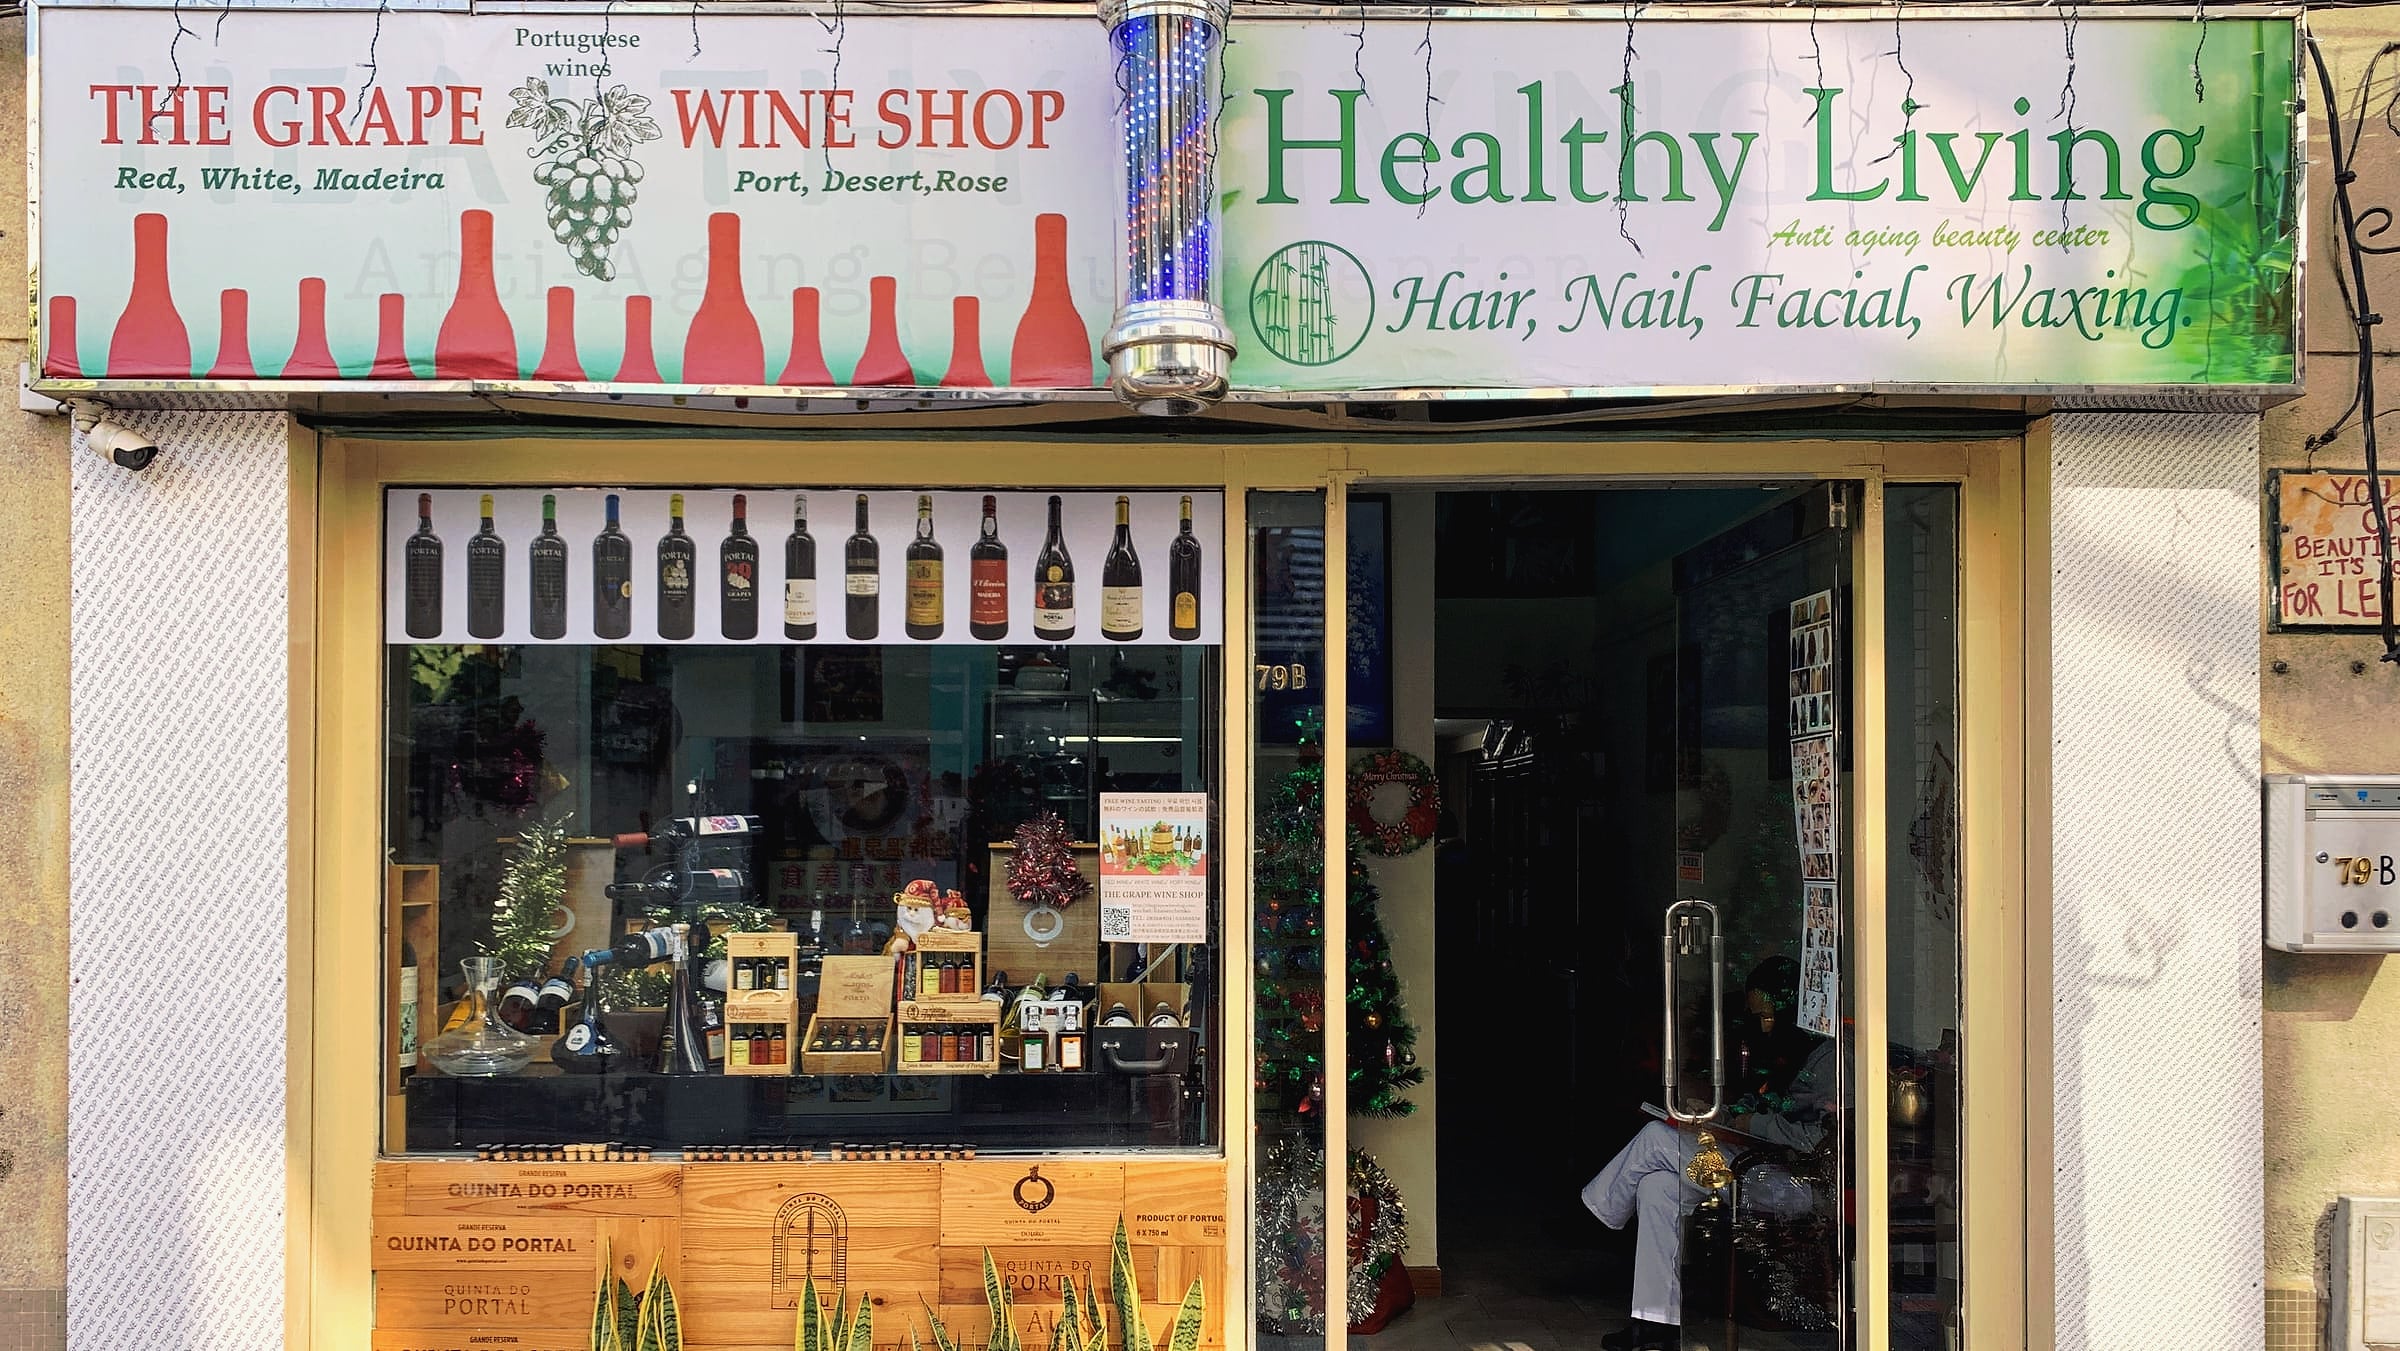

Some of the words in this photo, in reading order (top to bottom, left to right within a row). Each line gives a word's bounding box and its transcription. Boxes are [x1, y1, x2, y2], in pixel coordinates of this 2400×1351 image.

[515, 26, 640, 51] Portuguese
[545, 57, 612, 77] wines
[89, 84, 232, 147] THE
[253, 85, 486, 149] GRAPE
[671, 89, 856, 149] WINE
[877, 89, 1065, 150] SHOP
[1253, 80, 1759, 232] Healthy
[1802, 87, 2204, 231] Living
[114, 166, 187, 194] Red,
[200, 166, 302, 195] White,
[312, 167, 445, 191] Madeira
[734, 170, 809, 196] Port,
[1767, 217, 1831, 249] Anti
[1845, 223, 1919, 257] aging
[1932, 218, 2020, 255] beauty
[2032, 224, 2111, 248] center
[1385, 270, 1538, 342] Hair,
[1558, 264, 1705, 341] Nail,
[1731, 264, 1921, 341] Facial,
[1947, 263, 2193, 350] Waxing.
[73, 562, 88, 578] THE
[83, 536, 105, 564] GRAPE
[101, 517, 119, 538] WINE
[114, 496, 133, 519] SHOP
[130, 481, 143, 497] THE
[139, 455, 161, 482] GRAPE
[157, 433, 176, 457] WINE
[170, 414, 189, 437] SHOP
[79, 567, 98, 591] SHOP
[94, 552, 108, 569] THE
[104, 527, 126, 554] GRAPE
[121, 505, 141, 529] WINE
[135, 486, 154, 509] SHOP
[150, 470, 165, 487] THE
[160, 446, 181, 473] GRAPE
[177, 425, 195, 448] WINE
[87, 577, 106, 599] WINE
[101, 555, 121, 579] SHOP
[117, 540, 131, 557] THE
[127, 515, 148, 542] GRAPE
[144, 495, 162, 517] WINE
[157, 475, 176, 497] SHOP
[172, 459, 187, 476] THE
[182, 434, 204, 461] GRAPE
[199, 415, 217, 436] WINE
[95, 585, 115, 609] SHOP
[110, 570, 125, 587] THE
[120, 544, 143, 573] GRAPE
[137, 526, 155, 548] WINE
[151, 504, 170, 528] SHOP
[166, 489, 181, 506] THE
[176, 465, 197, 491] GRAPE
[193, 445, 211, 467] WINE
[207, 423, 226, 447] SHOP
[104, 594, 124, 617] WINE
[118, 573, 138, 597] SHOP
[133, 558, 148, 575] THE
[143, 532, 166, 561] GRAPE
[160, 512, 180, 536] WINE
[174, 492, 194, 516] SHOP
[189, 477, 204, 494] THE
[199, 452, 221, 479] GRAPE
[216, 432, 235, 454] WINE
[533, 548, 562, 557] PORTAL
[661, 551, 690, 561] PORTAL
[724, 551, 754, 562] PORTAL
[2318, 557, 2364, 576] IT'S
[2282, 583, 2323, 618] FOR
[1386, 770, 1418, 781] Christmas
[1104, 891, 1121, 899] THE
[1122, 891, 1152, 899] GRAPE
[1153, 891, 1178, 899] WINE
[1179, 891, 1204, 899] SHOP
[448, 1183, 522, 1198] QUINTA
[528, 1183, 557, 1198] DO
[562, 1183, 635, 1198] PORTAL
[1017, 1199, 1049, 1211] PORTAL
[1136, 1214, 1176, 1223] PRODUCT
[1177, 1214, 1189, 1222] OF
[387, 1236, 462, 1252] QUINTA
[468, 1237, 496, 1252] DO
[502, 1237, 577, 1253] PORTAL
[1006, 1260, 1063, 1272] QUINTA
[1071, 1260, 1092, 1271] DO
[444, 1285, 501, 1296] QUINTA
[509, 1285, 530, 1295] DO
[444, 1298, 530, 1316] PORTAL
